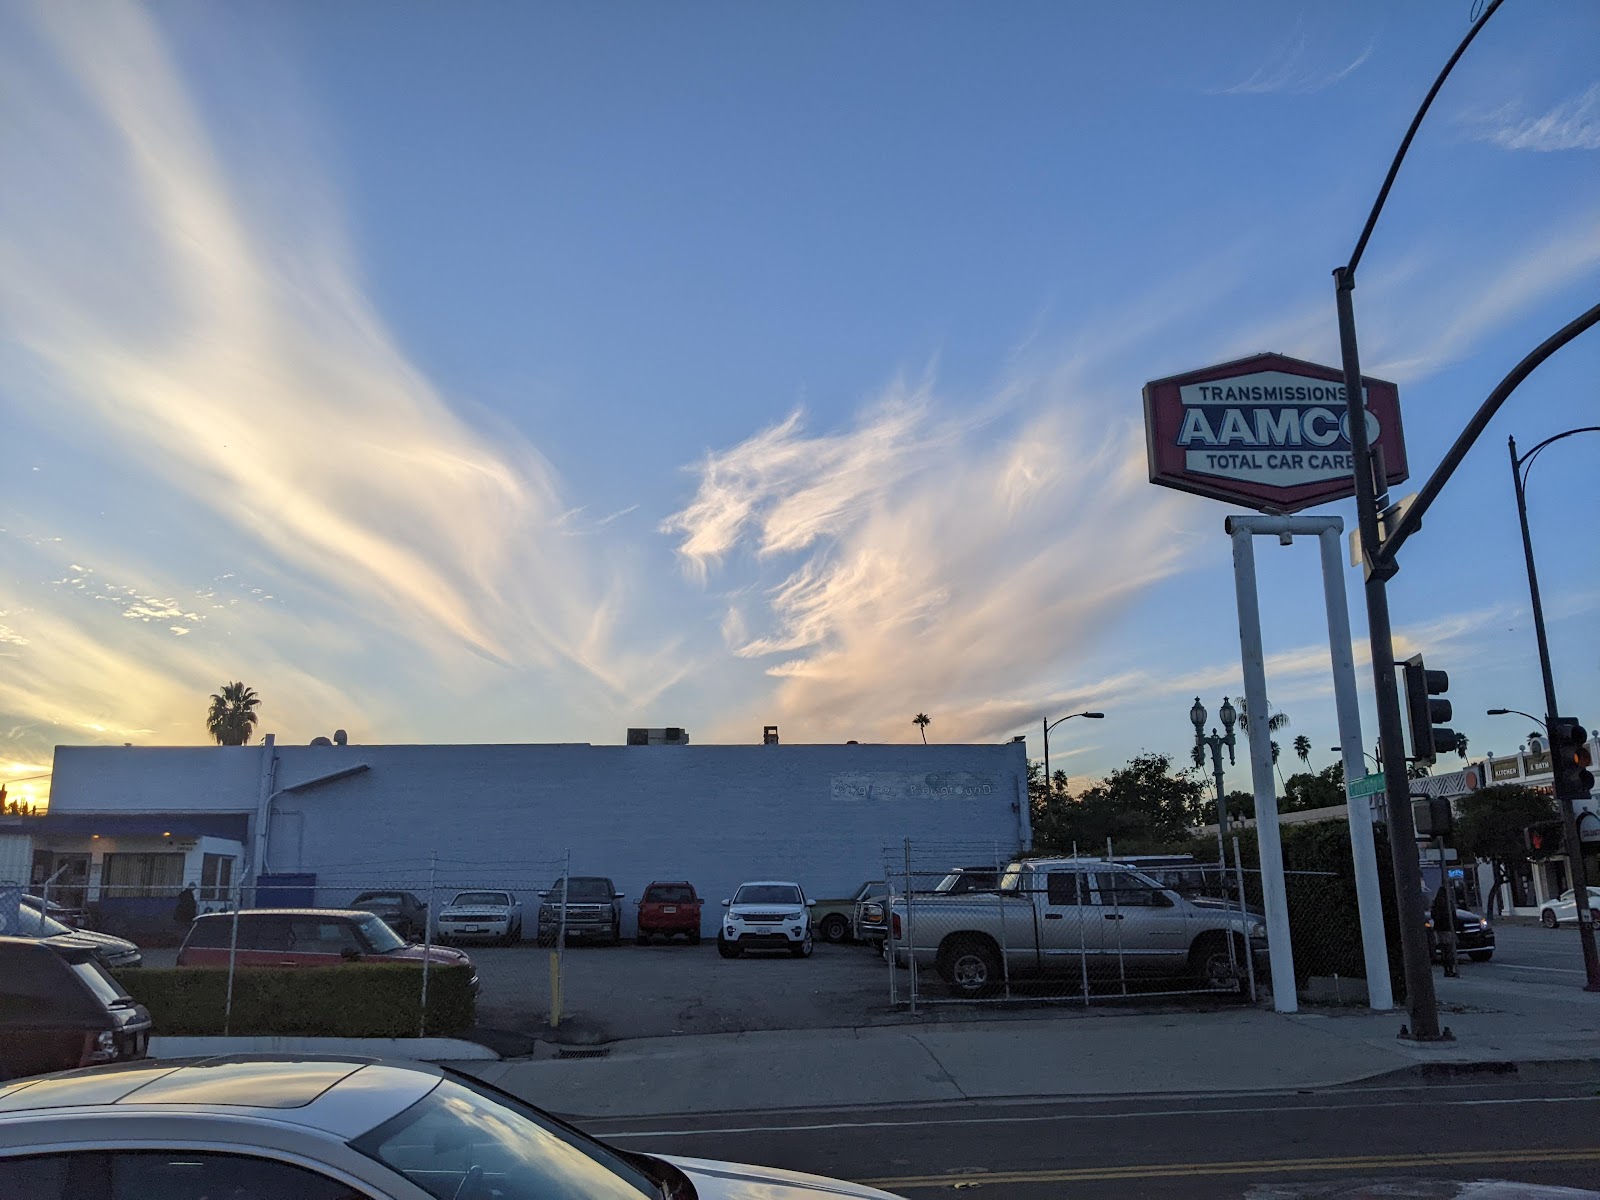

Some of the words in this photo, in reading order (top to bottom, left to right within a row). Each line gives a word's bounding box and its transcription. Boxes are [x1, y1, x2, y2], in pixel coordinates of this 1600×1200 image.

[1199, 386, 1347, 401] TRANSMISSIONS
[1177, 407, 1381, 446] AAMCO
[1206, 454, 1262, 469] TOTAL
[1267, 454, 1303, 469] CAR
[1308, 454, 1354, 469] CARE
